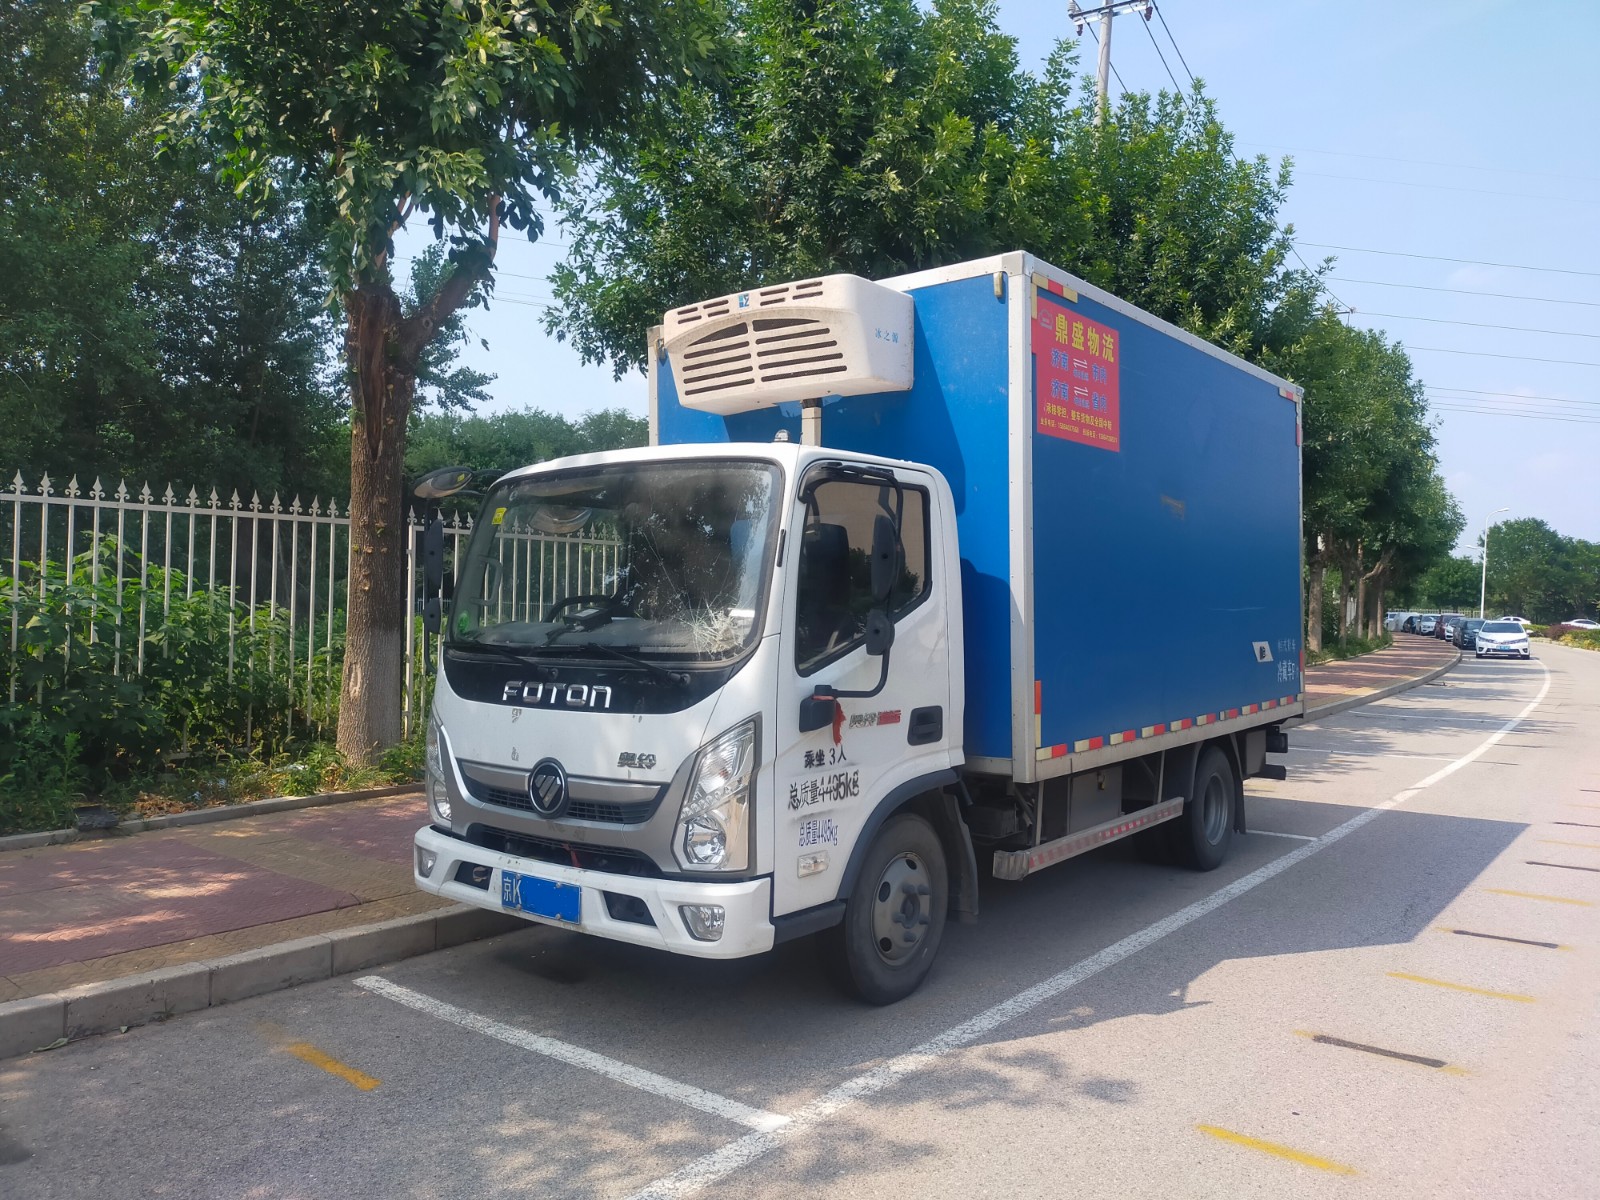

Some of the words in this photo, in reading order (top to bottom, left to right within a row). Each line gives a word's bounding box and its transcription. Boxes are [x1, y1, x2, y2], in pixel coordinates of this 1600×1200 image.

[1055, 313, 1114, 363] 鼎盛物流
[502, 680, 612, 709] FOTON
[503, 877, 522, 905] 京K
